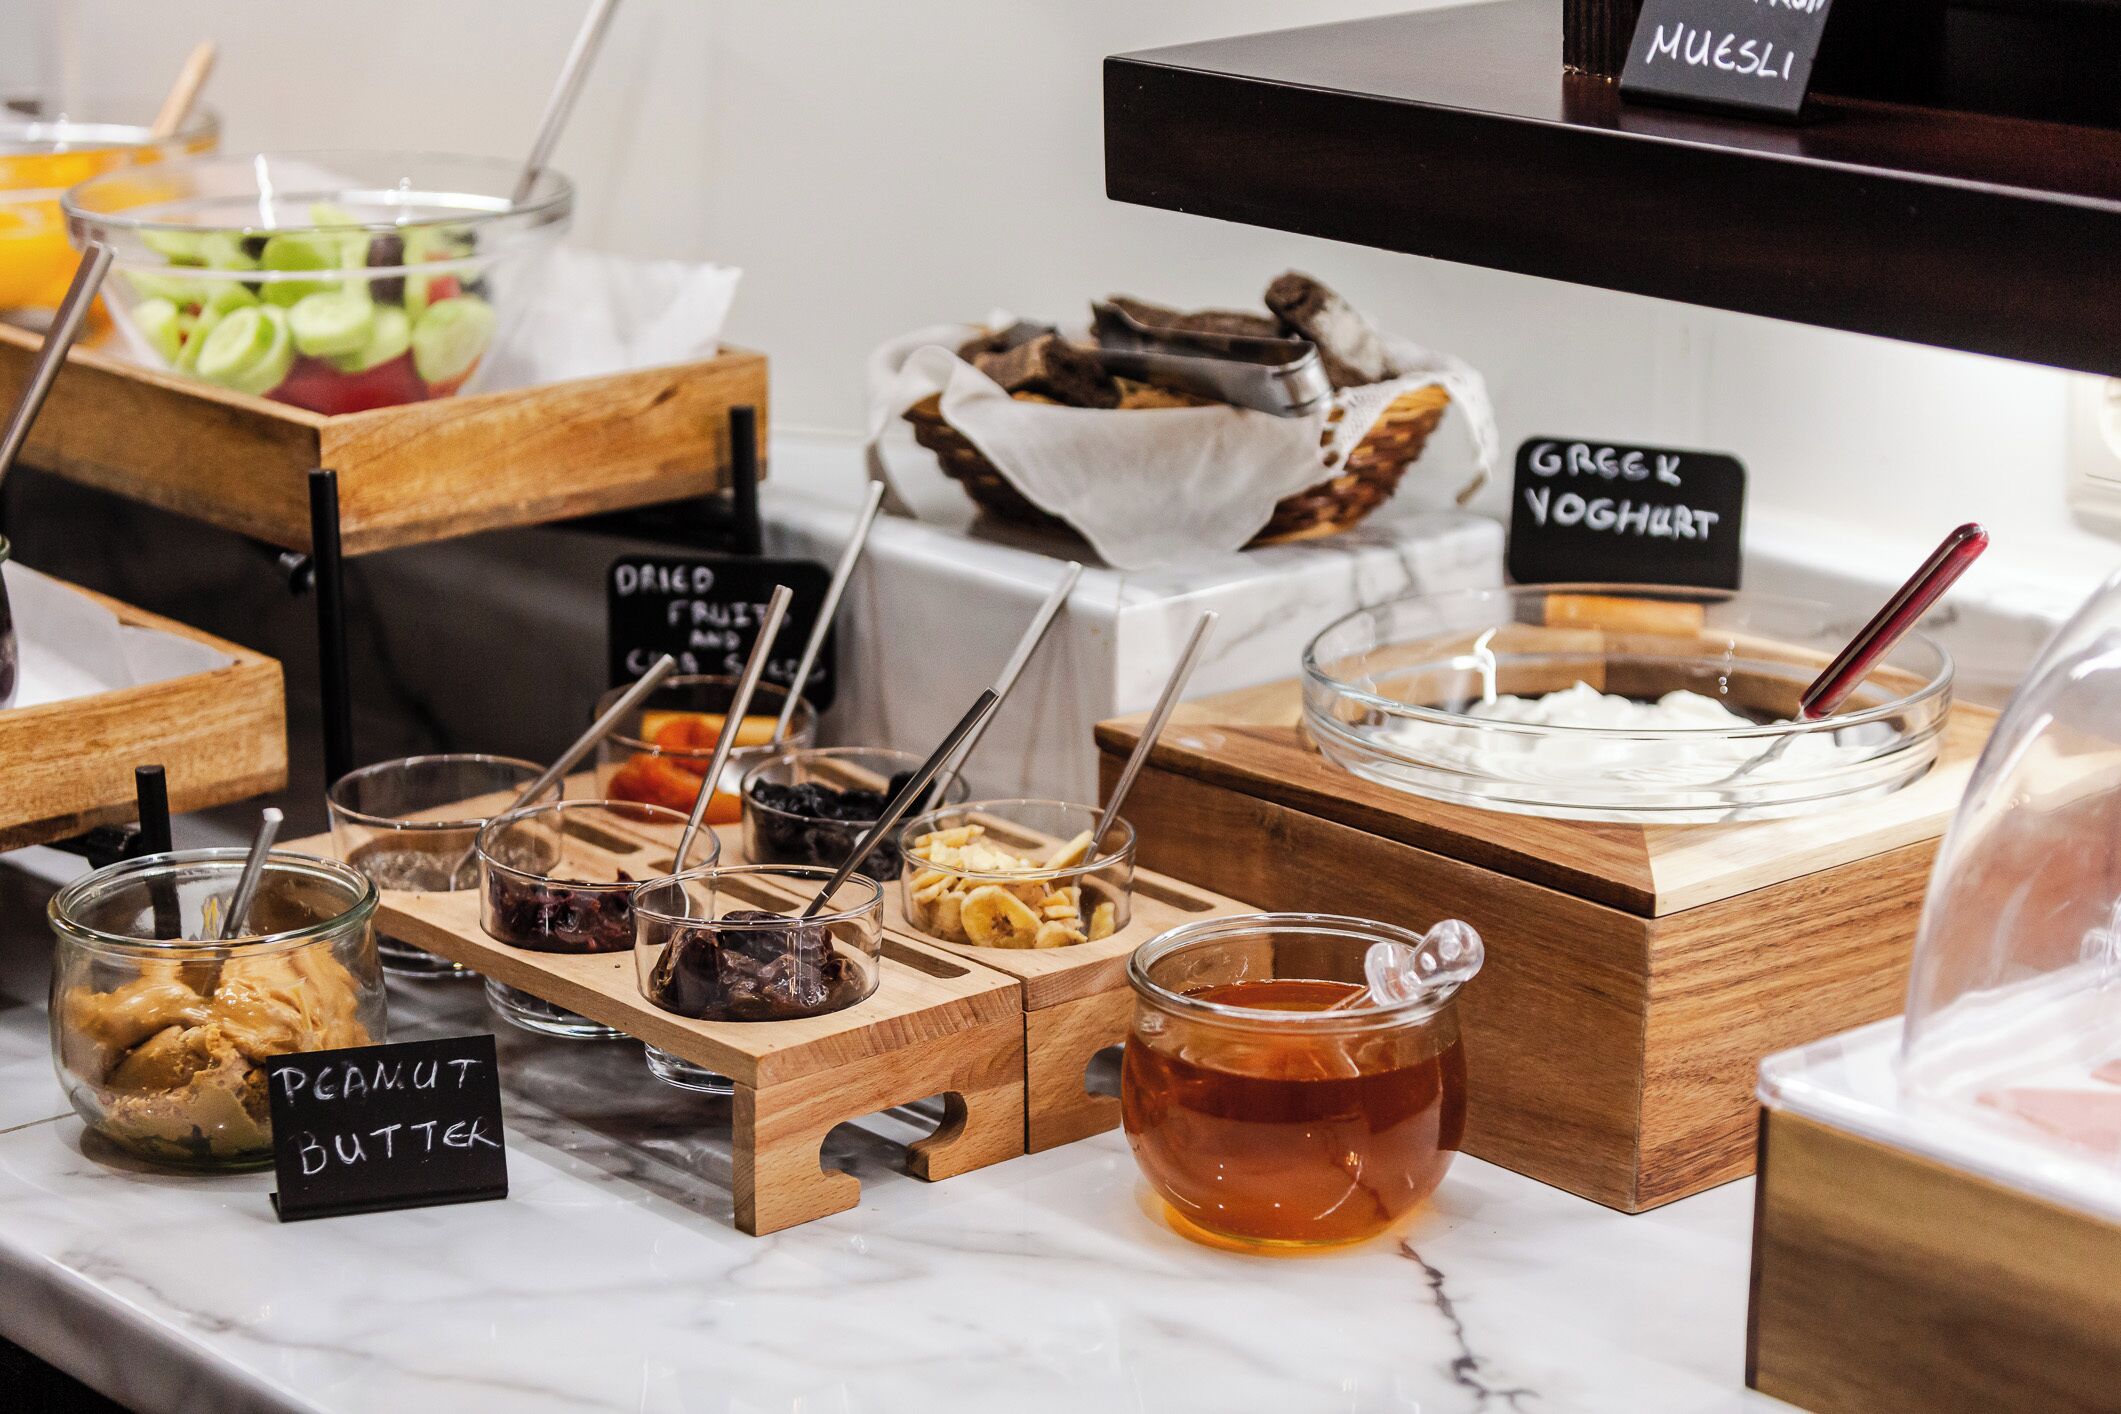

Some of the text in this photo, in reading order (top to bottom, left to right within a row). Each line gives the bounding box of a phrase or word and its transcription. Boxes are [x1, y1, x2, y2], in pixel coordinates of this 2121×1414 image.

[1645, 22, 1795, 81] MUESLI
[1528, 442, 1682, 487] GREEK
[1524, 486, 1720, 541] YOGHURT
[614, 563, 715, 597] DRIED
[689, 630, 741, 650] AND
[272, 1058, 482, 1104] PEANUT
[293, 1116, 501, 1175] BUTTER
